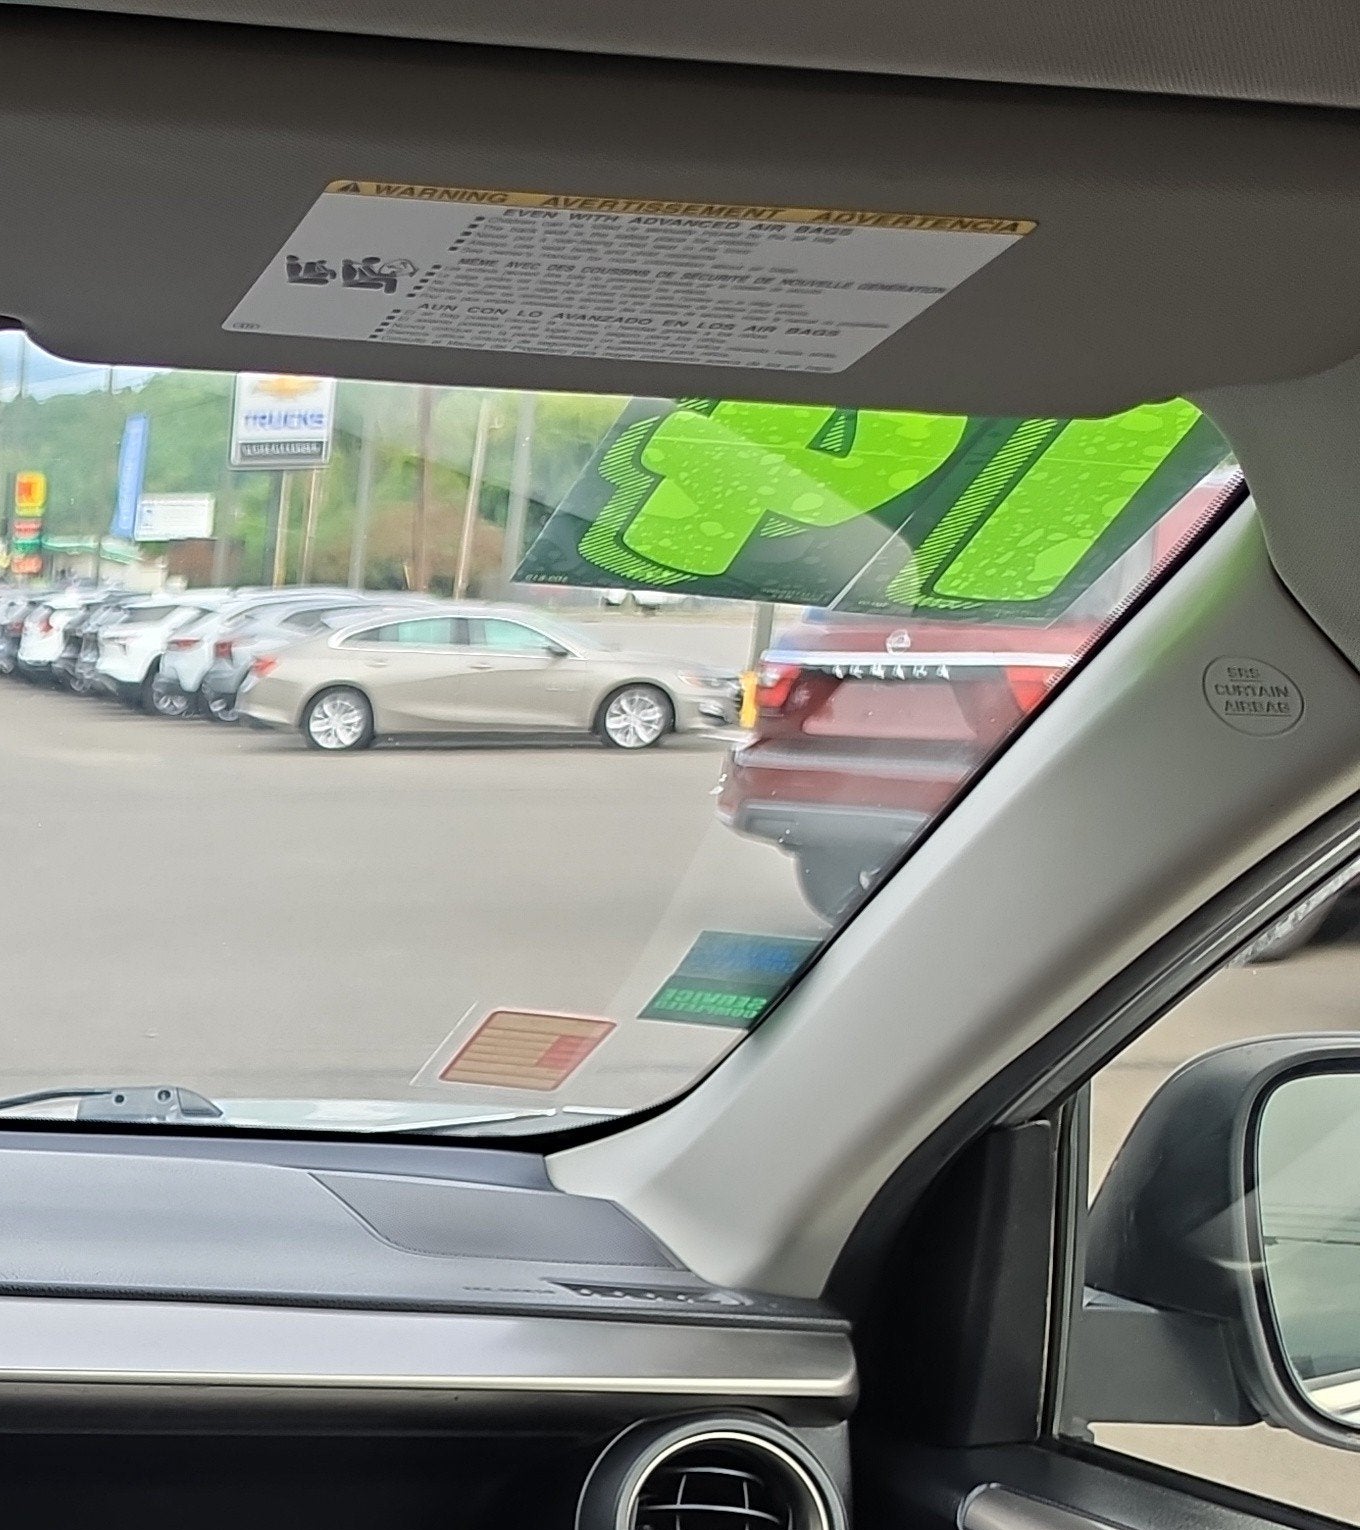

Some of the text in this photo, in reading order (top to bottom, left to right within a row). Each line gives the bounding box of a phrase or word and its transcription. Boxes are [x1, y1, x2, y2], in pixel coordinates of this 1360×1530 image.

[375, 185, 1022, 233] WARNING AVERTISSEMENT ADVERTENCIA
[502, 209, 559, 220] EVEN
[568, 213, 619, 223] WITH
[1214, 683, 1289, 697] CURTAIN
